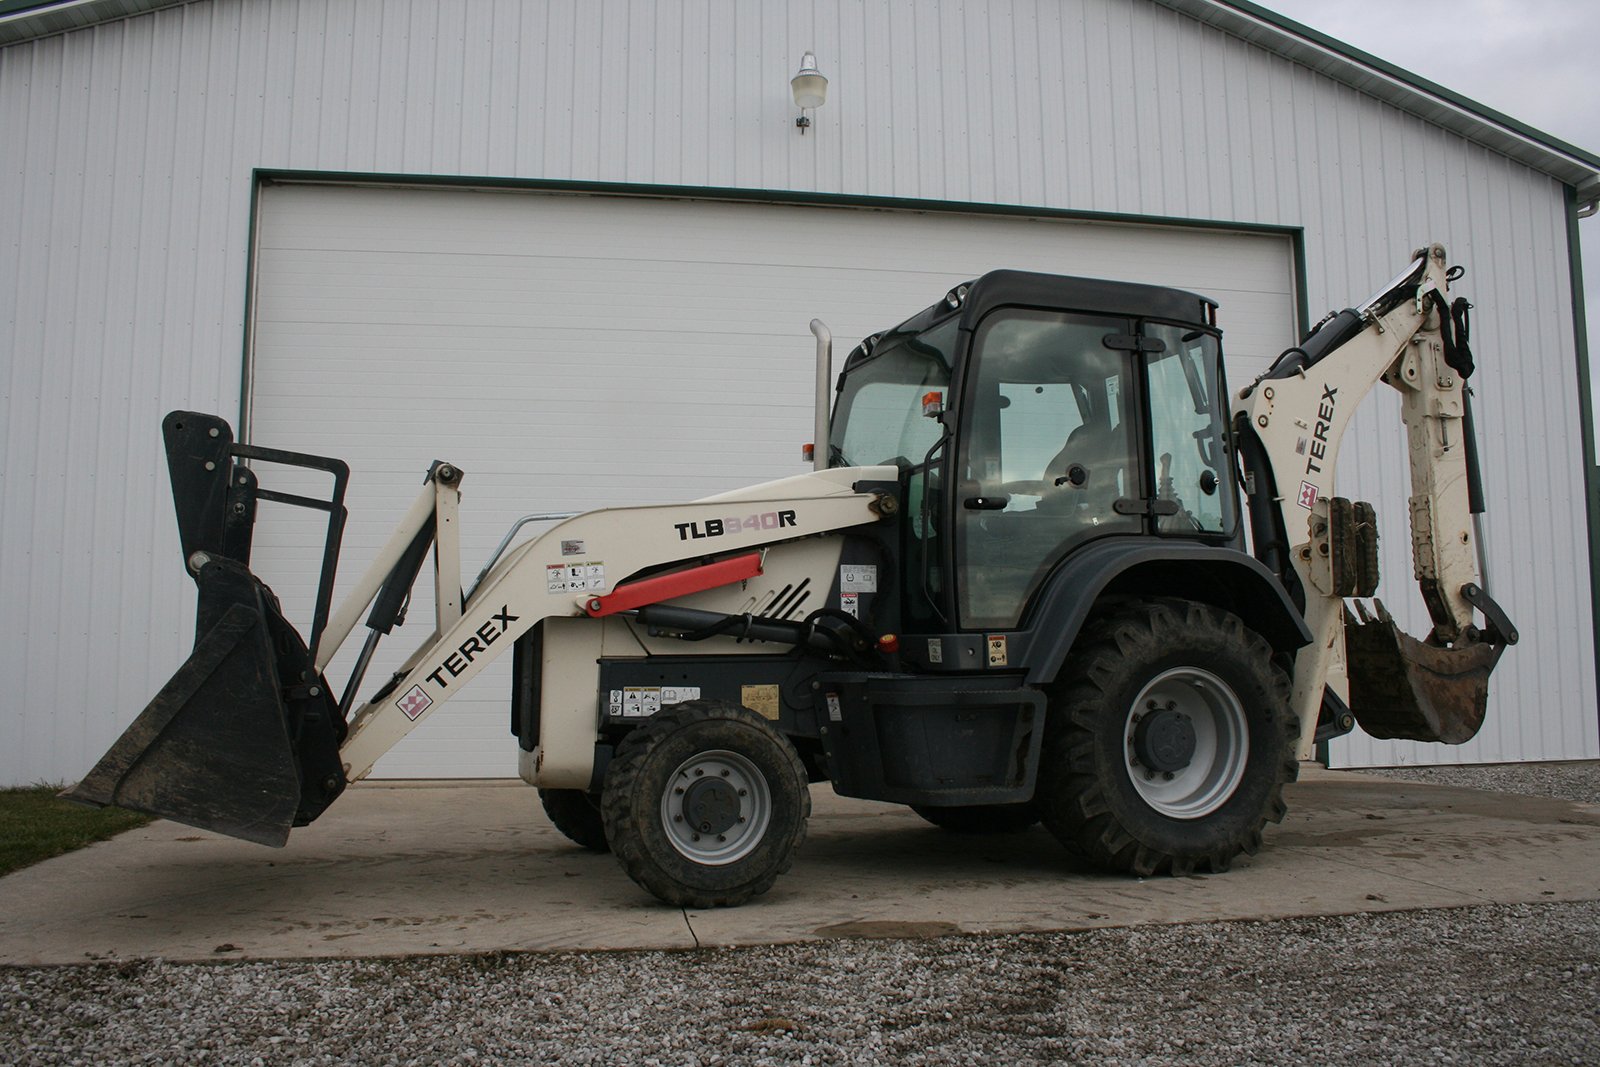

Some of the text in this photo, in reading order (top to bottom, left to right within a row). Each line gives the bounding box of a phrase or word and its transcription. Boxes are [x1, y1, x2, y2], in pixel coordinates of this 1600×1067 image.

[1306, 383, 1338, 475] TEREX
[674, 509, 797, 541] TLB840R
[425, 604, 520, 688] TEREX
